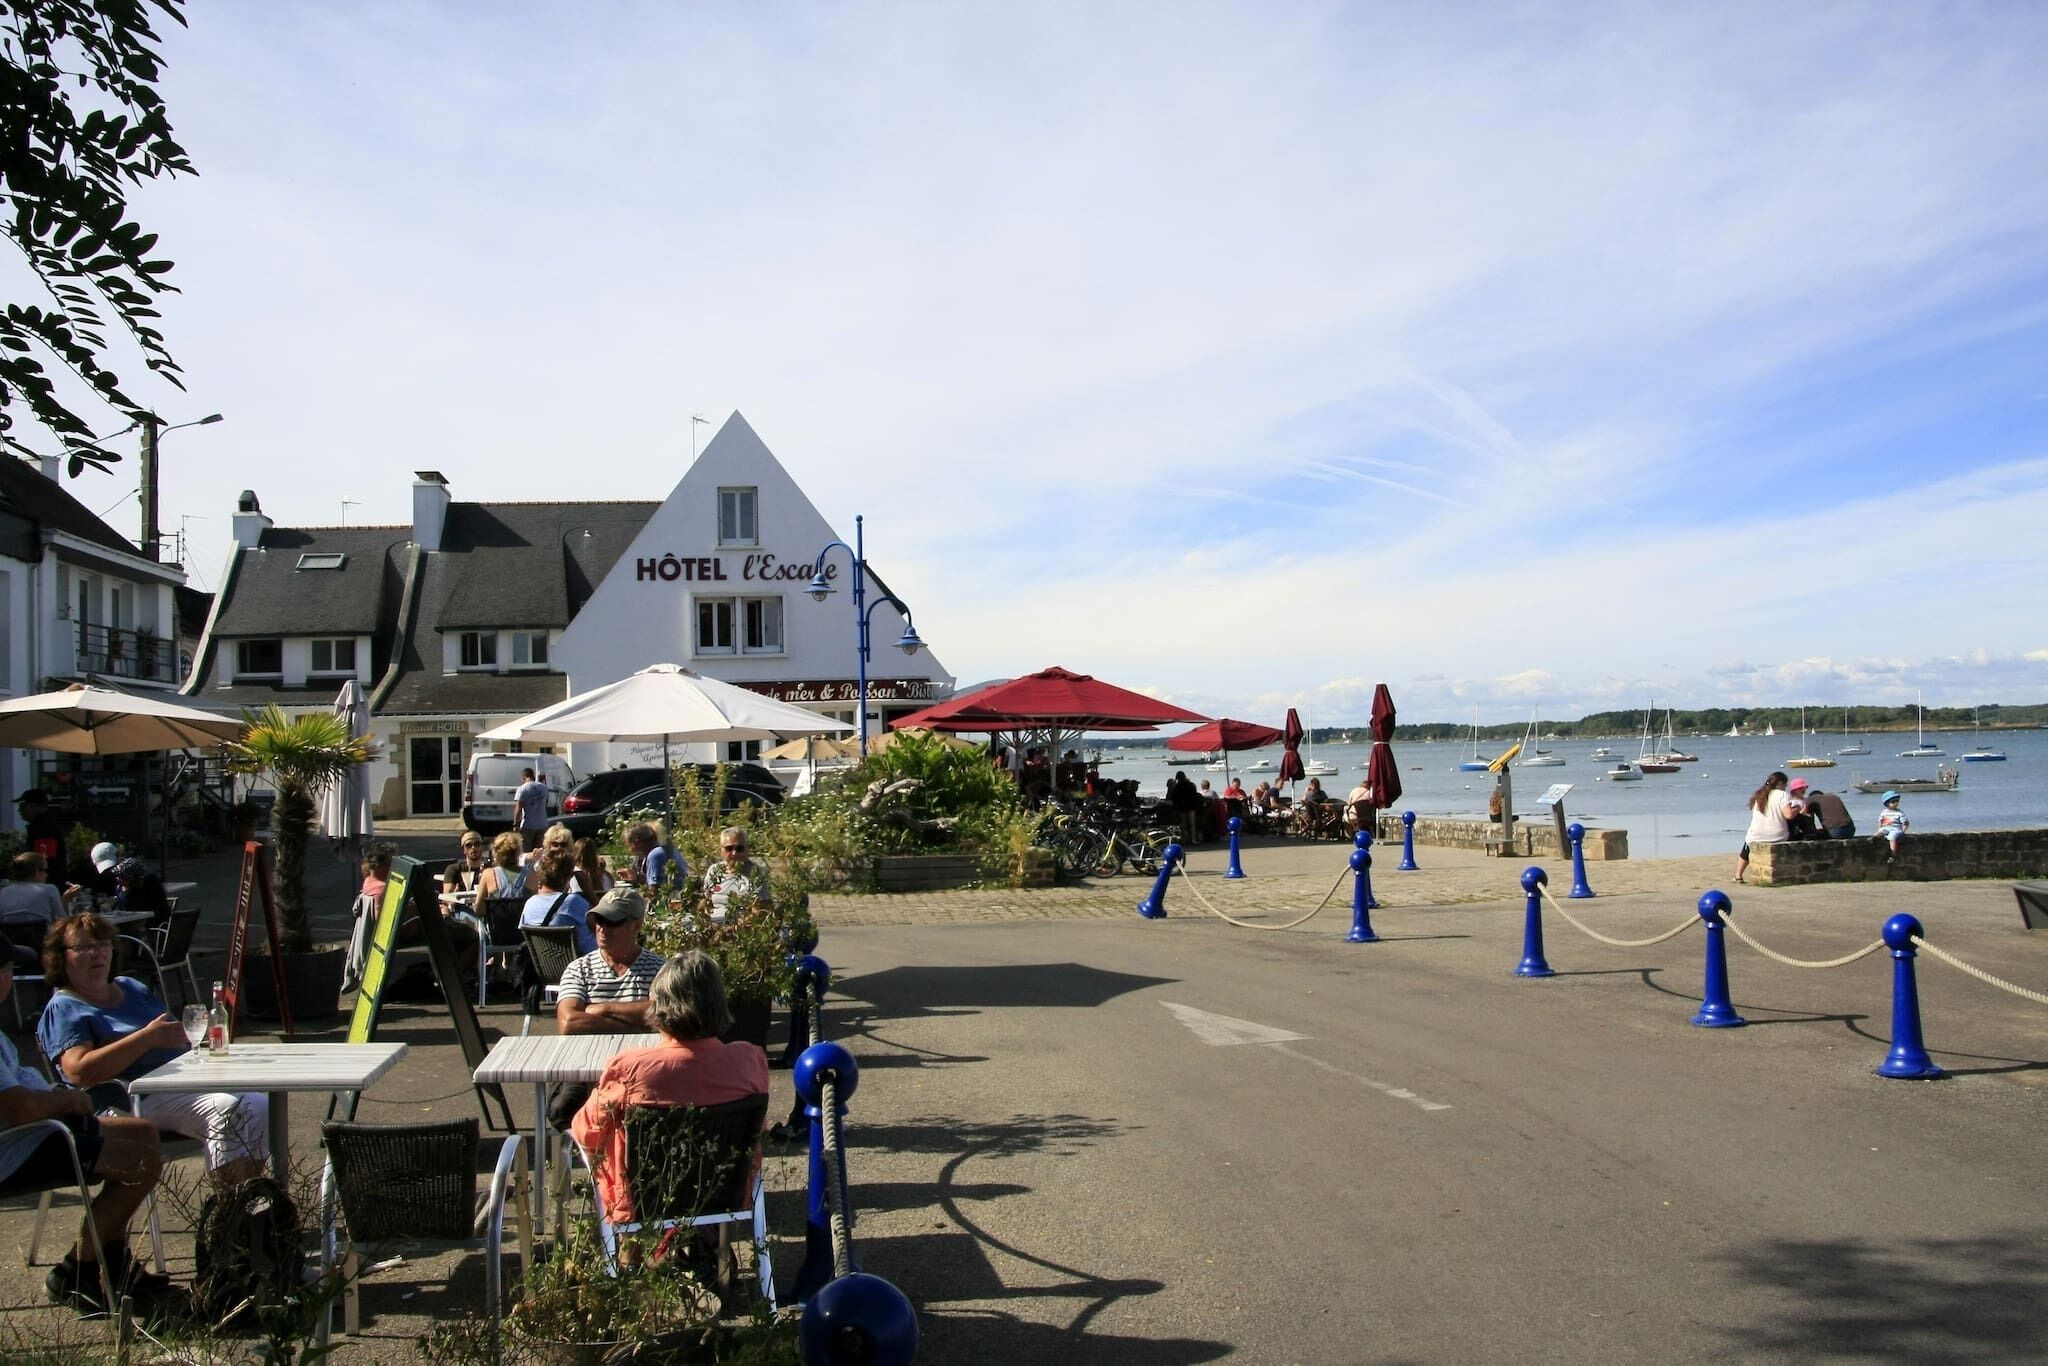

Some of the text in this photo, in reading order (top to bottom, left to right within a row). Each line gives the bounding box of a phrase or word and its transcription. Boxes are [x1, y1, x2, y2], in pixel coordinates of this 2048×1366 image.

[637, 553, 727, 581] HÔTEL
[786, 689, 816, 701] mer
[820, 684, 835, 700] &
[838, 683, 897, 699] Posson
